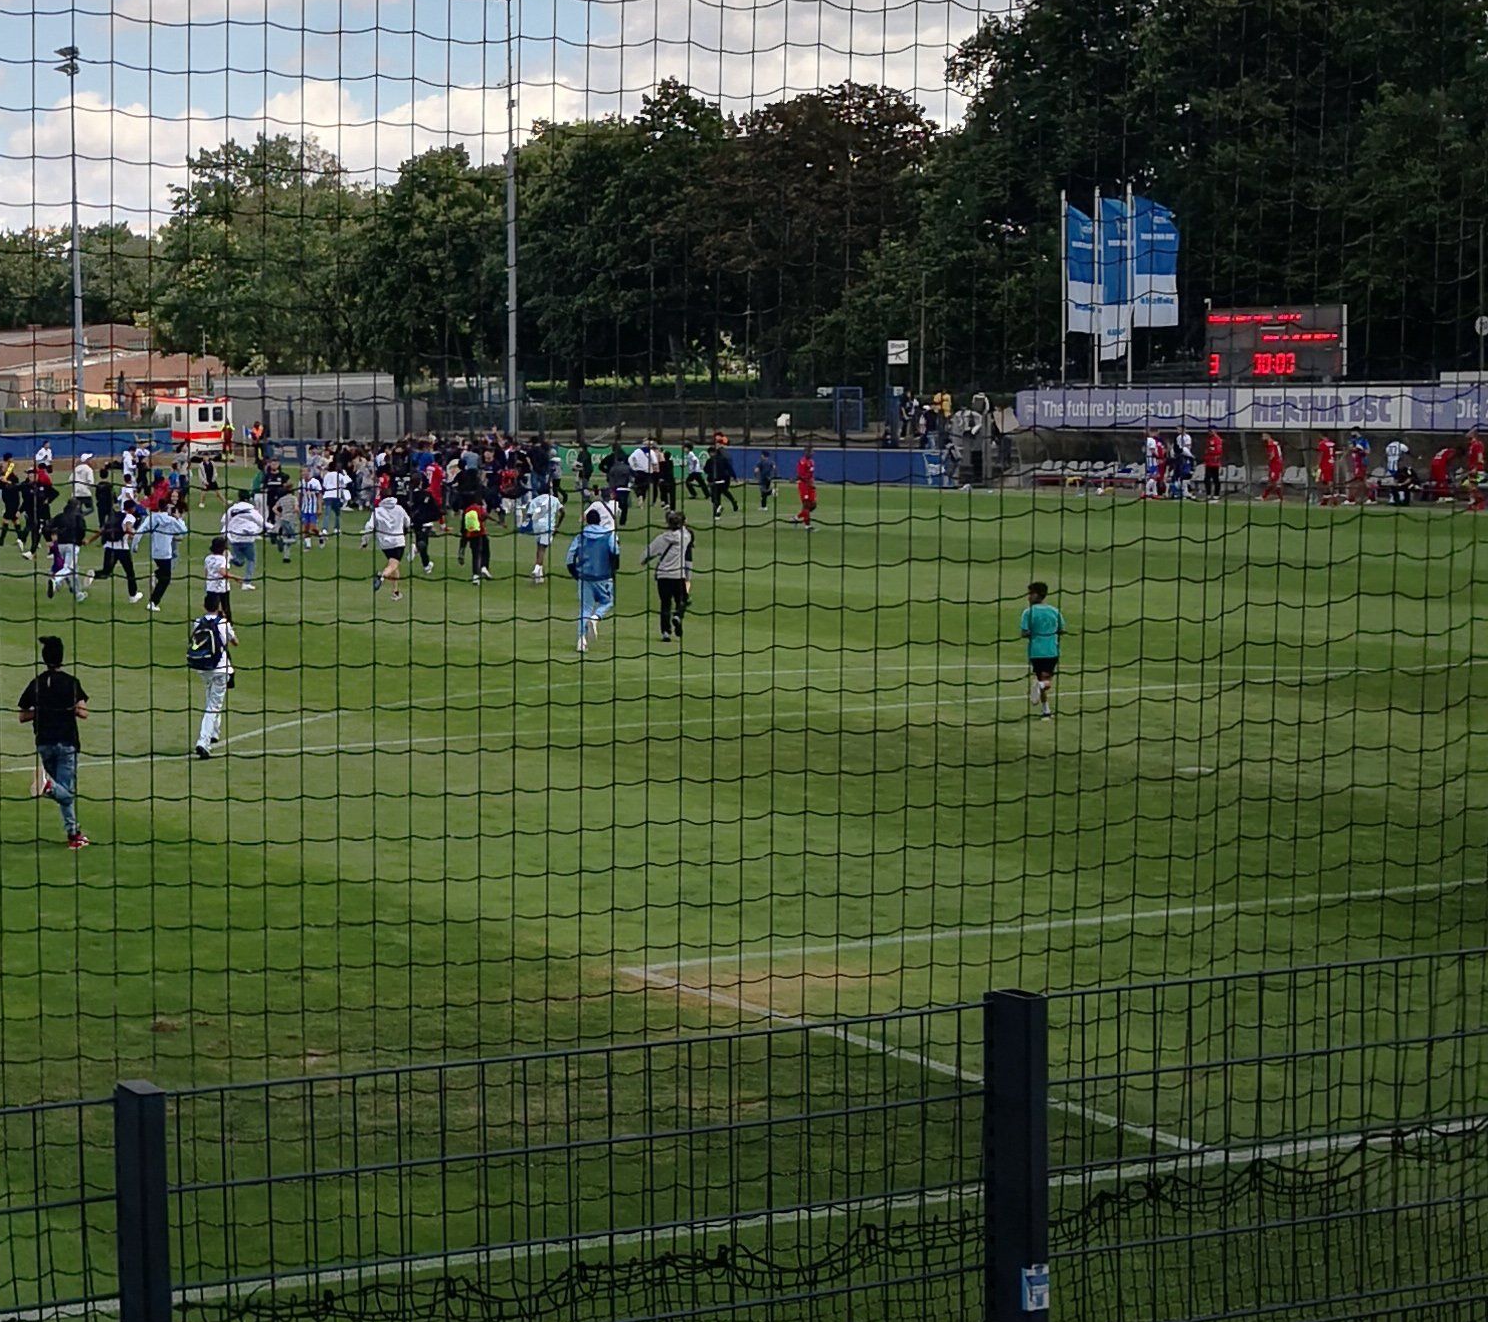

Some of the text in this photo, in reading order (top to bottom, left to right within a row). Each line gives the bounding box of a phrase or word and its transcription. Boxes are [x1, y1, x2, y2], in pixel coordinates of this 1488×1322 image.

[1042, 400, 1064, 417] The
[1066, 399, 1104, 417] future
[1106, 400, 1155, 420] belongs
[1158, 402, 1172, 417] to
[1253, 395, 1344, 422] HERTHA
[1348, 395, 1392, 422] BSC
